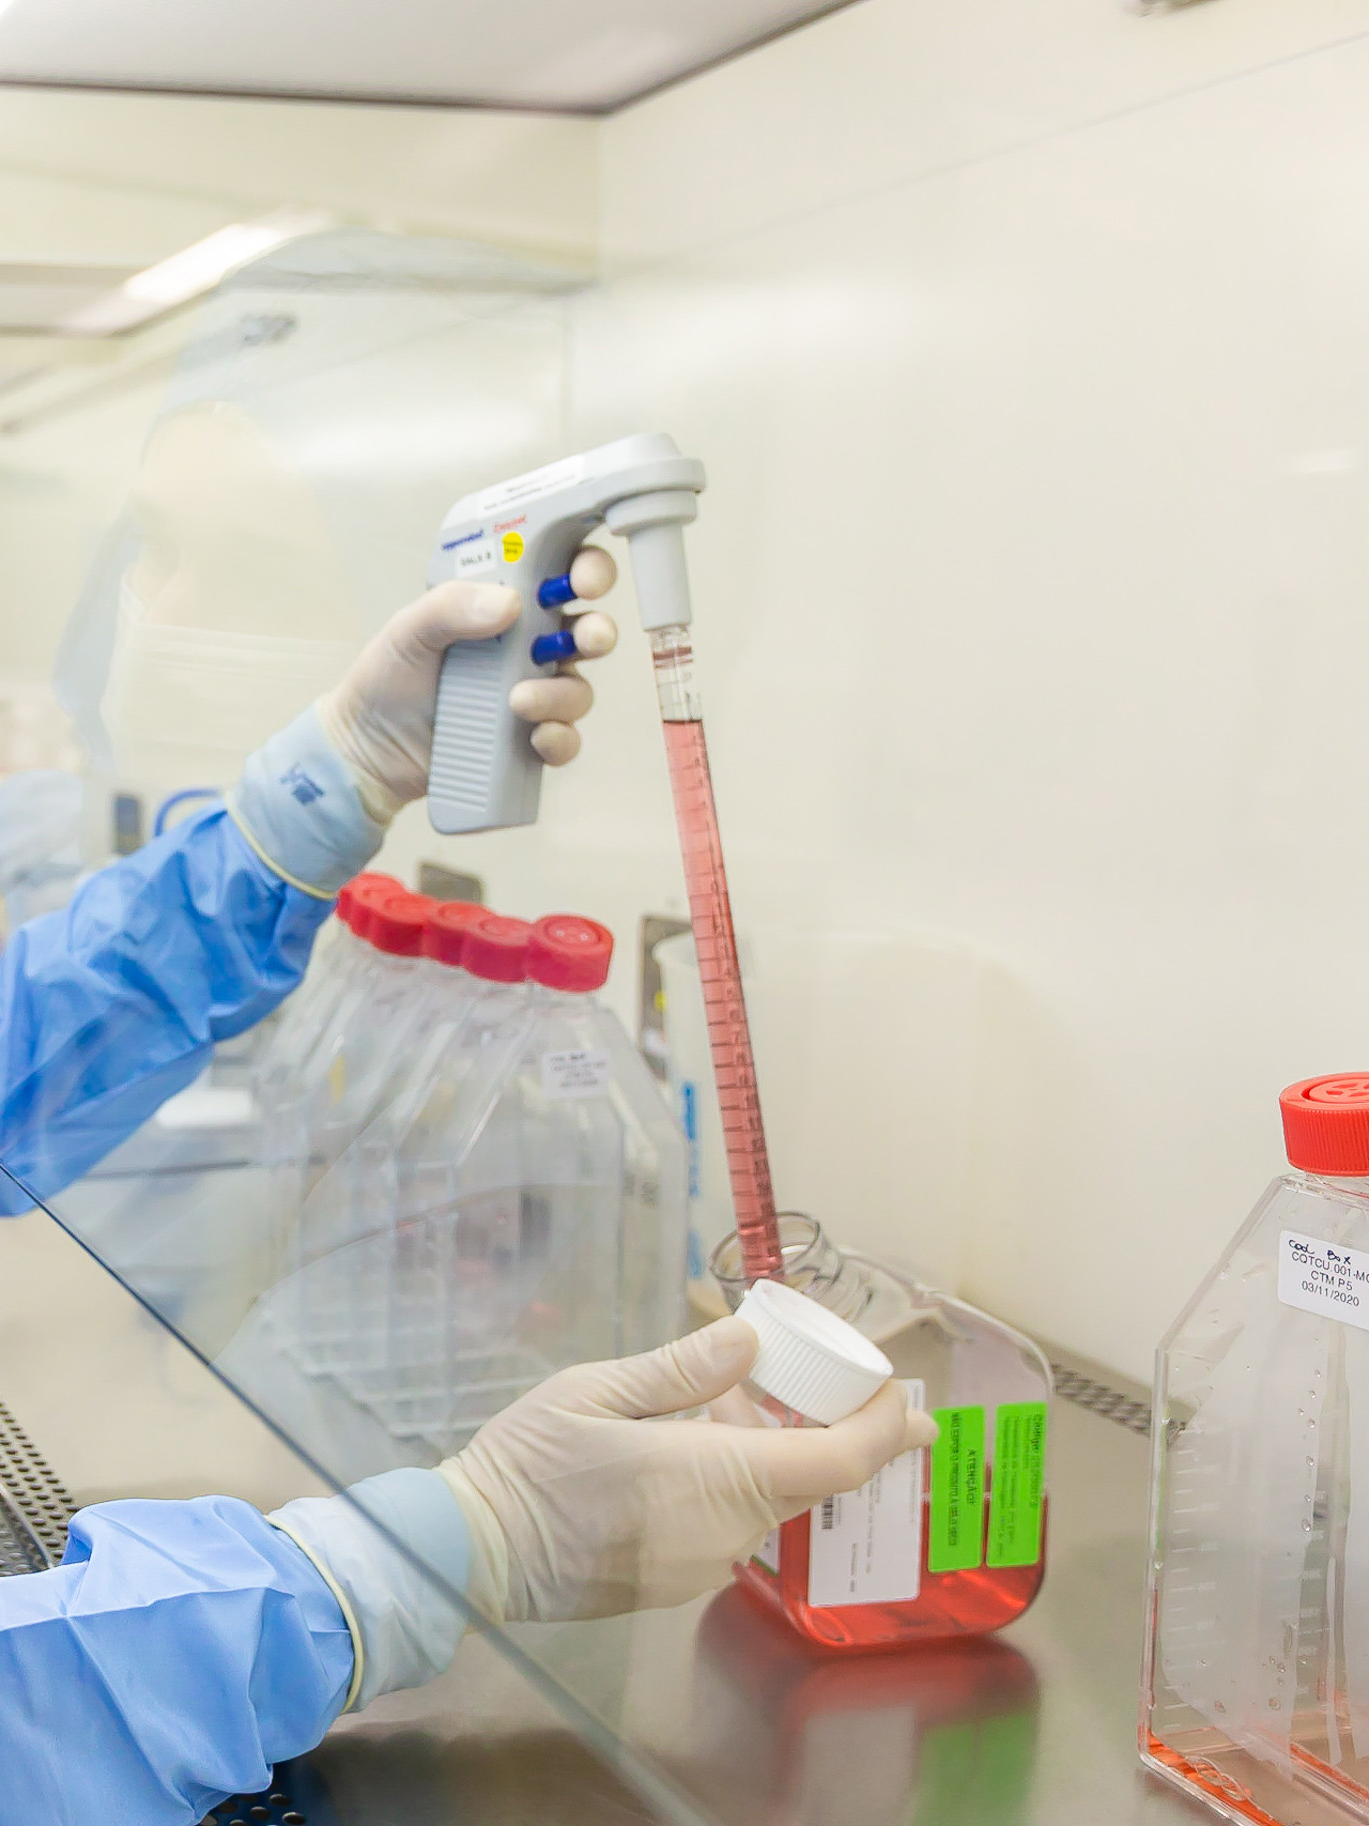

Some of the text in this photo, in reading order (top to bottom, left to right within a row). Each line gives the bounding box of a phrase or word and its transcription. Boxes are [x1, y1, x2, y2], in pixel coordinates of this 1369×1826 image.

[1327, 1249, 1352, 1265] Box
[1310, 1270, 1353, 1292] CTM P5
[1301, 1280, 1360, 1308] 03/11/2020
